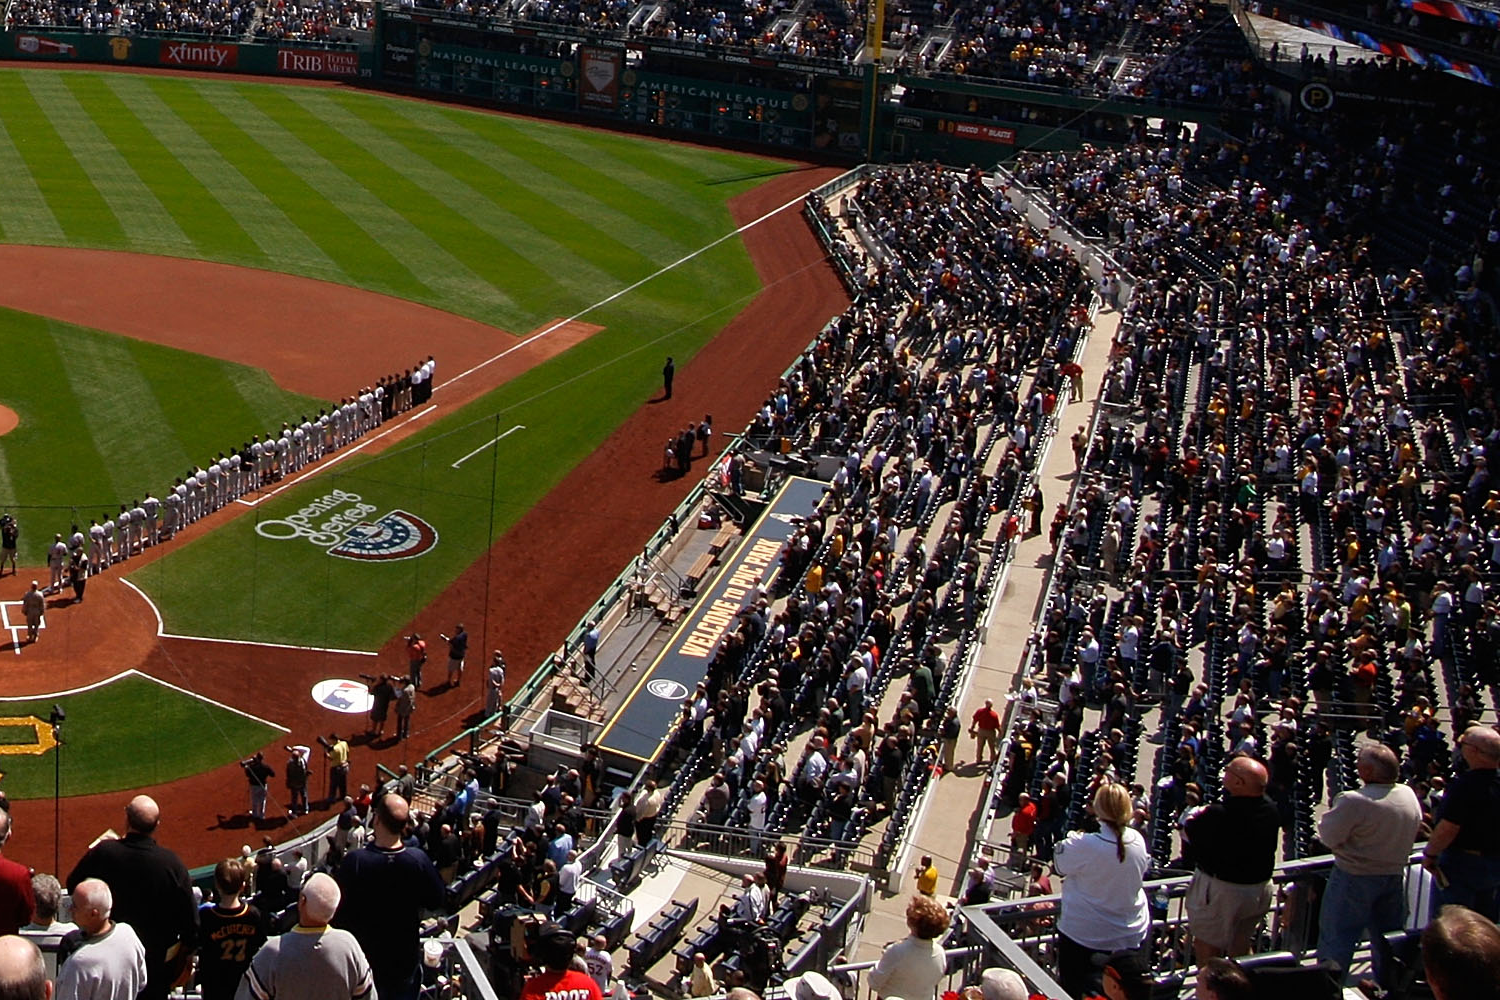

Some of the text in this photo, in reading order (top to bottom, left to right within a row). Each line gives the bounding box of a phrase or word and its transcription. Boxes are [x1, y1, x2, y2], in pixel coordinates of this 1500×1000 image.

[169, 42, 228, 66] xfinity
[603, 40, 626, 48] CONSOL
[278, 50, 322, 72] TRIB
[327, 54, 357, 65] TOTAL
[327, 63, 357, 75] MEDIA
[433, 50, 557, 76] NATIONAL LEAGUE
[725, 55, 750, 64] CONSOL
[639, 80, 789, 110] AMERICAN LEAGUE
[1311, 89, 1323, 105] P
[255, 489, 362, 540] Opening
[309, 502, 377, 546] Series
[679, 538, 782, 657] WELCOME TO PNC PARK
[587, 962, 604, 976] 52
